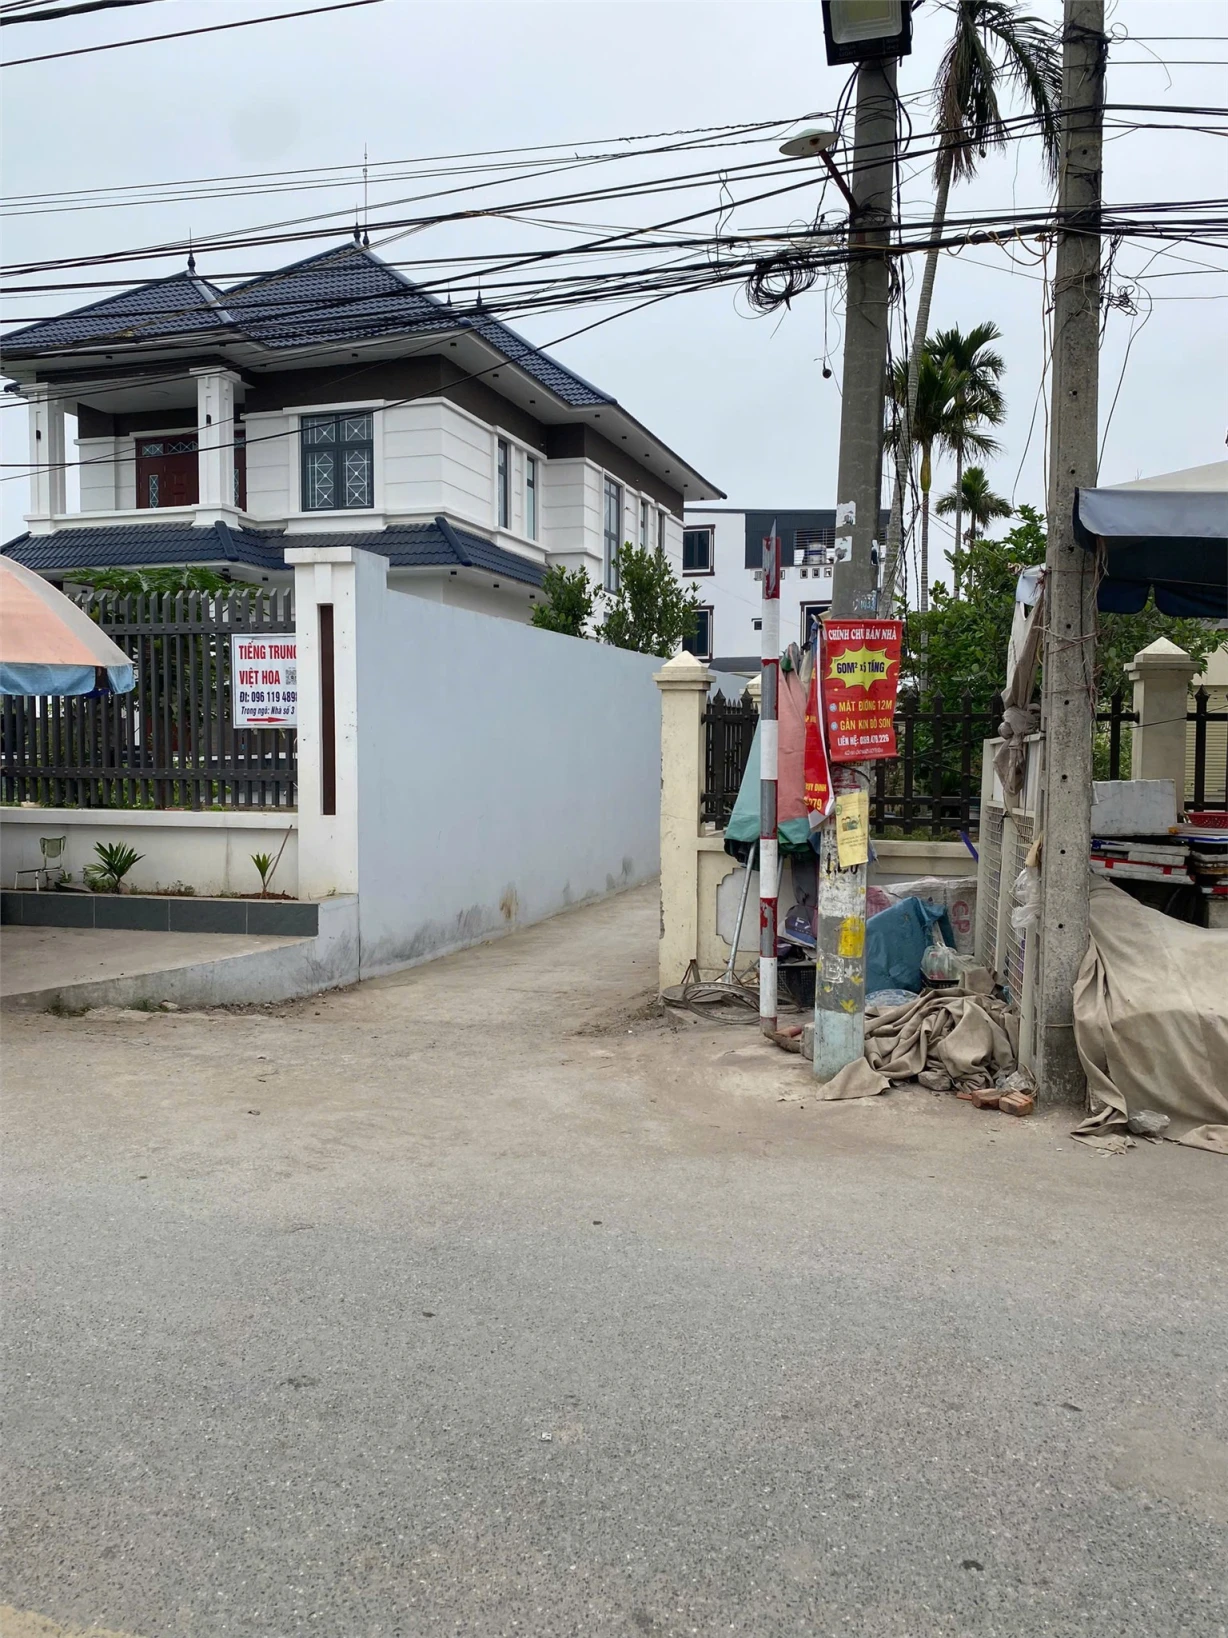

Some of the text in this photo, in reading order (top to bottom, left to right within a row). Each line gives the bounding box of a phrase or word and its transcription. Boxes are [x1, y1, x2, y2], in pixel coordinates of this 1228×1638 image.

[828, 624, 896, 639] CHÍNH CHỦ BÁN NHÀ
[238, 640, 266, 659] TIẾNG
[239, 667, 280, 688] VIỆT HOA
[251, 691, 264, 702] 096
[267, 691, 280, 702] 119
[241, 706, 256, 716] Trong
[271, 706, 282, 715] Nhà
[283, 705, 290, 715] số
[290, 706, 295, 715] 3
[877, 700, 892, 710] 12M
[878, 717, 891, 728] SƠN
[837, 735, 849, 746] LIÊN
